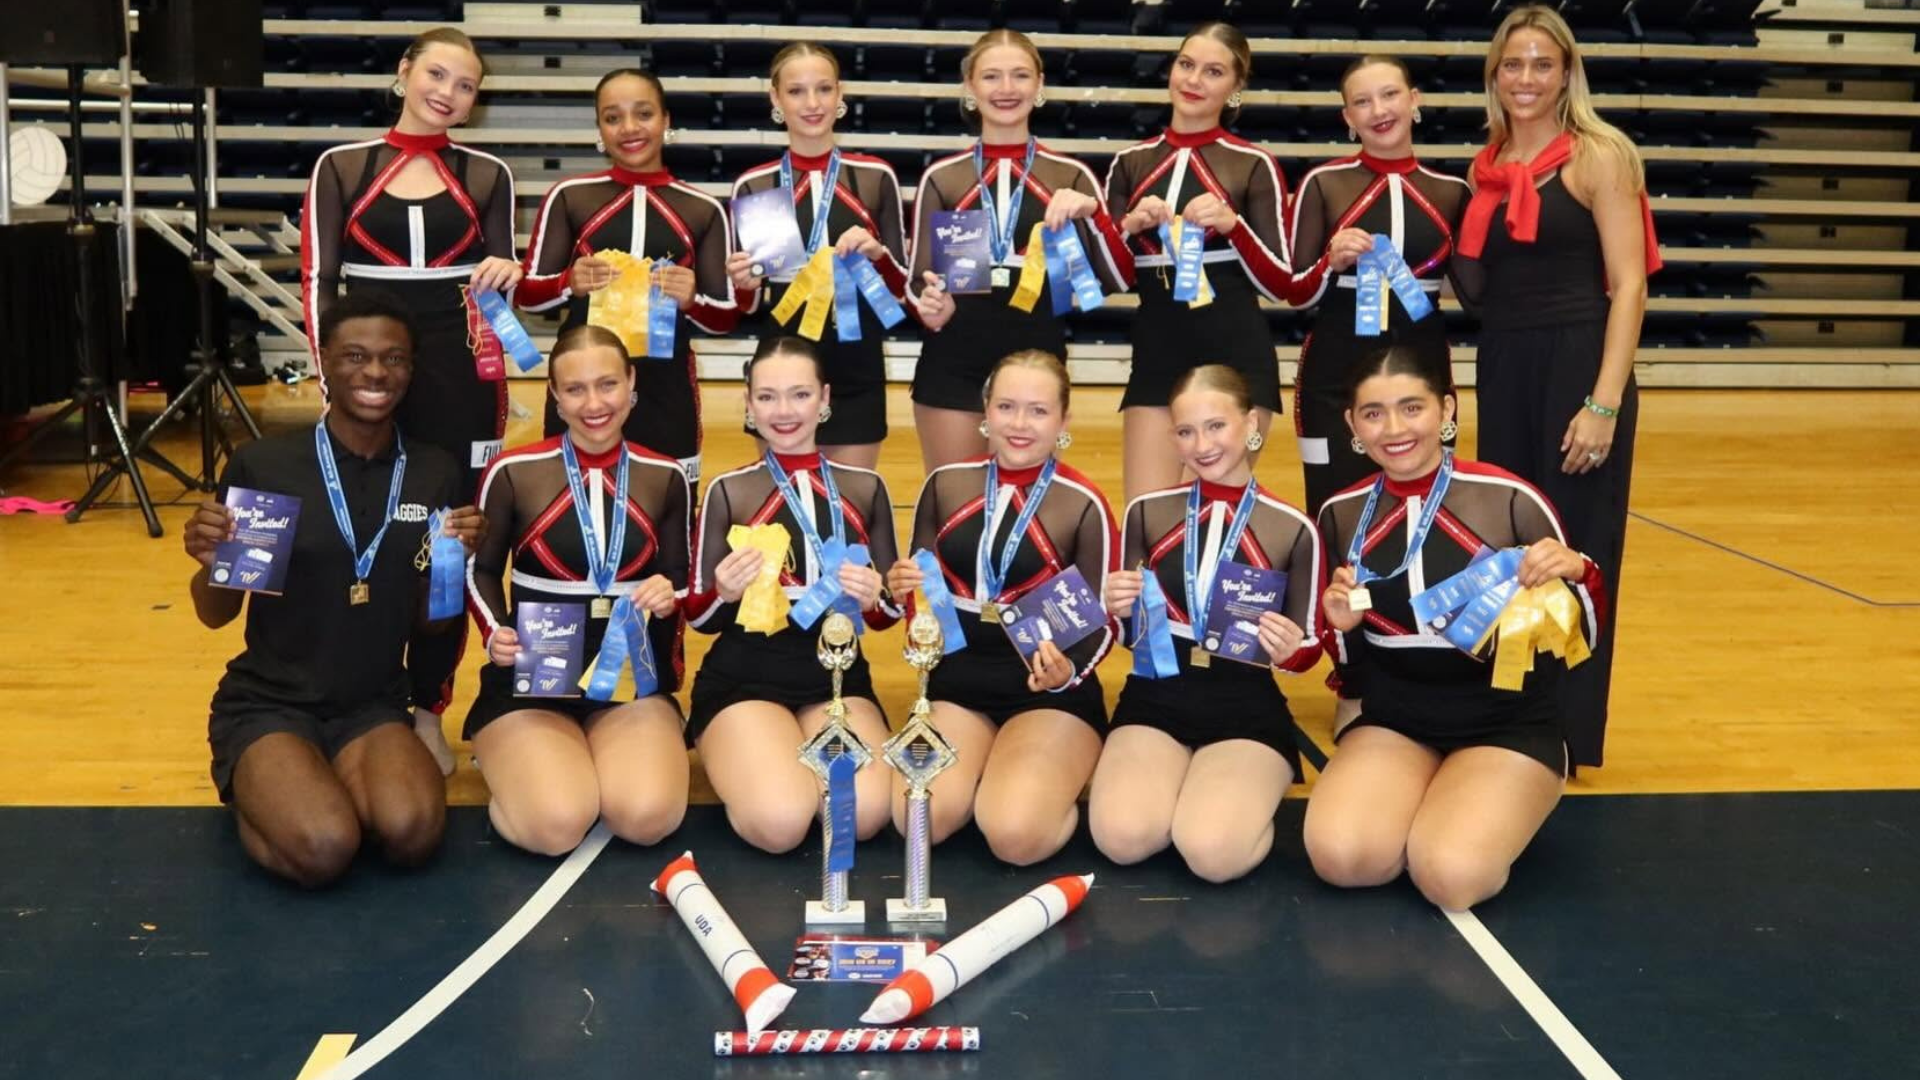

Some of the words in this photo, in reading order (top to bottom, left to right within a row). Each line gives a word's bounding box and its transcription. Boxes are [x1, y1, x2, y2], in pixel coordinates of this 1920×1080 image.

[233, 506, 264, 522] You're
[393, 503, 429, 522] AGGIES
[249, 516, 290, 530] Invited!
[1222, 579, 1252, 594] You're
[1237, 590, 1277, 604] Invited!
[694, 914, 713, 937] UDA
